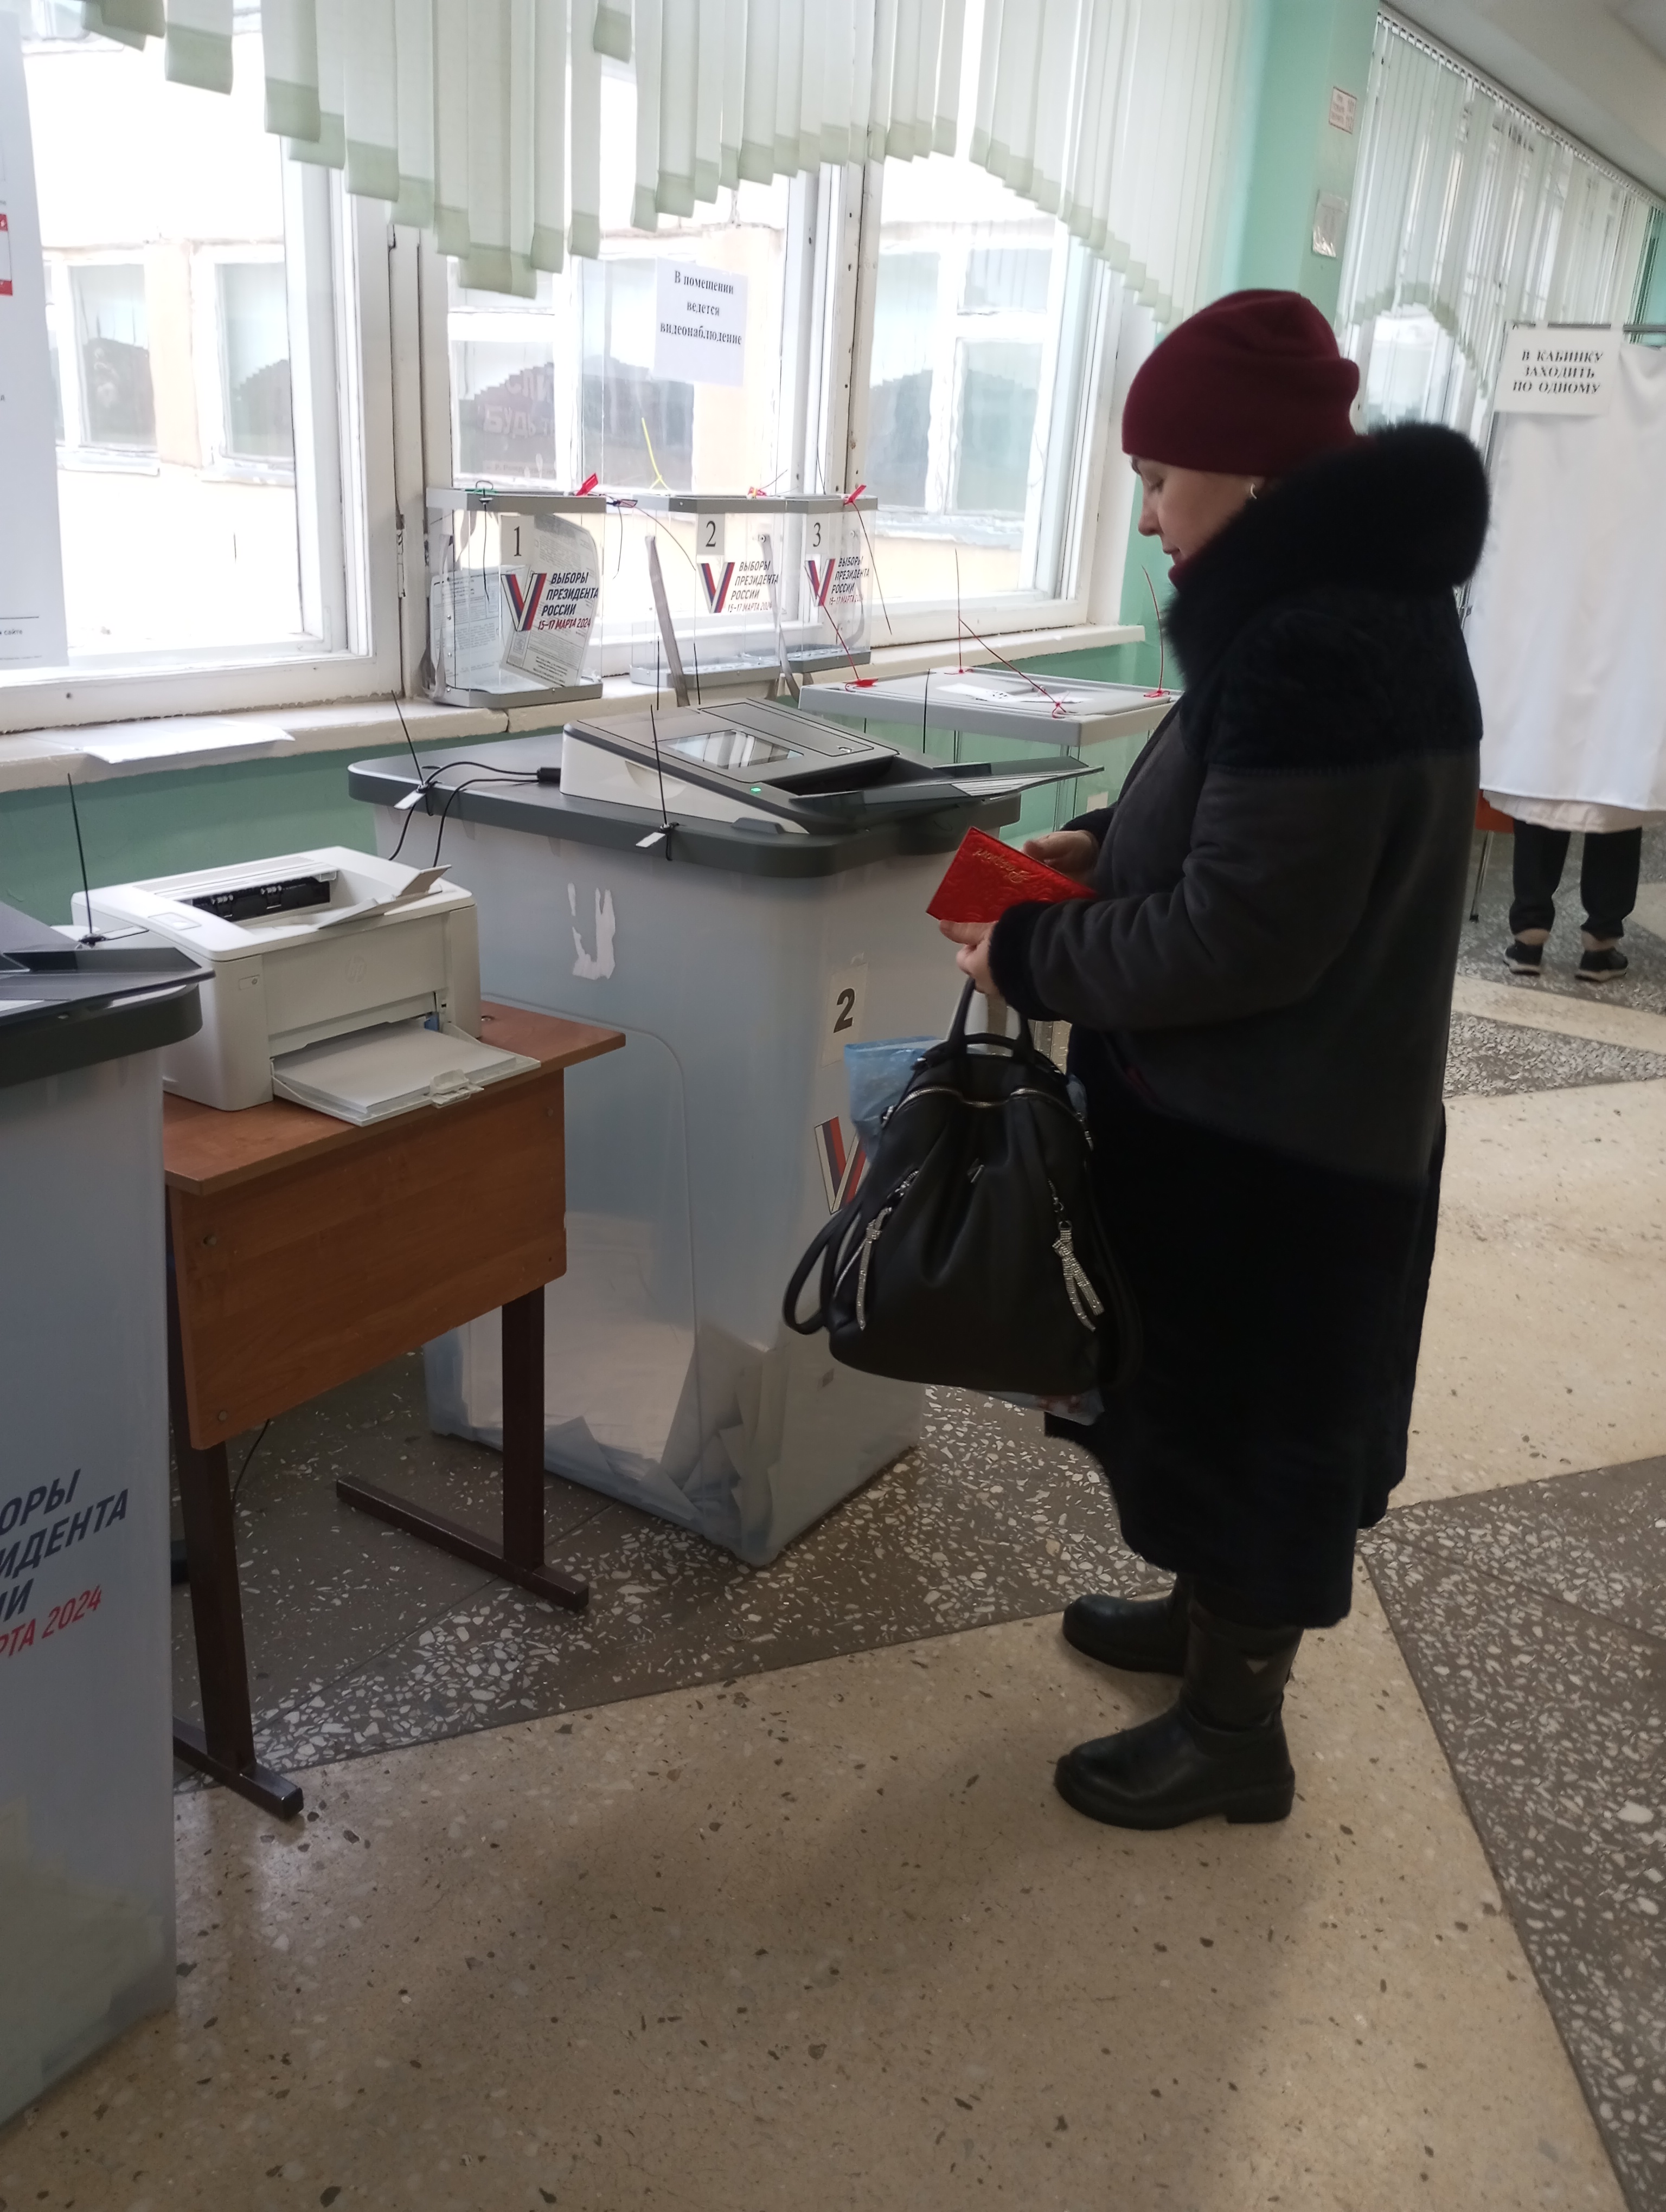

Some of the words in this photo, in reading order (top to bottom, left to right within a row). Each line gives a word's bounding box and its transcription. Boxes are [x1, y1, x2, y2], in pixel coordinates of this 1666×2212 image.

[675, 271, 681, 283] В
[684, 276, 734, 294] помещении
[687, 301, 720, 316] ведется
[660, 323, 742, 345] видеонаблюдение
[1522, 350, 1530, 361] В
[1537, 350, 1603, 362] КАБИНКУ
[1523, 365, 1594, 378] ЗАХОДИТЬ
[1513, 381, 1533, 391] ПО
[1539, 382, 1600, 394] ОДНОМУ
[706, 520, 716, 547] 2
[813, 522, 821, 548] 3
[514, 526, 522, 556] 1
[739, 560, 771, 571] ВЫБОРЫ
[550, 572, 589, 584] ВЫБОРЫ
[734, 574, 779, 587] ПРЕЗИДЕНТА
[546, 588, 599, 601] ПРЕЗИДЕНТА
[731, 589, 760, 600] РОССИИ
[541, 603, 576, 616] РОССИИ
[743, 602, 760, 613] МАРТА
[555, 619, 577, 631] МАРТА
[833, 988, 855, 1033] 2
[41, 1583, 102, 1639] 2024
